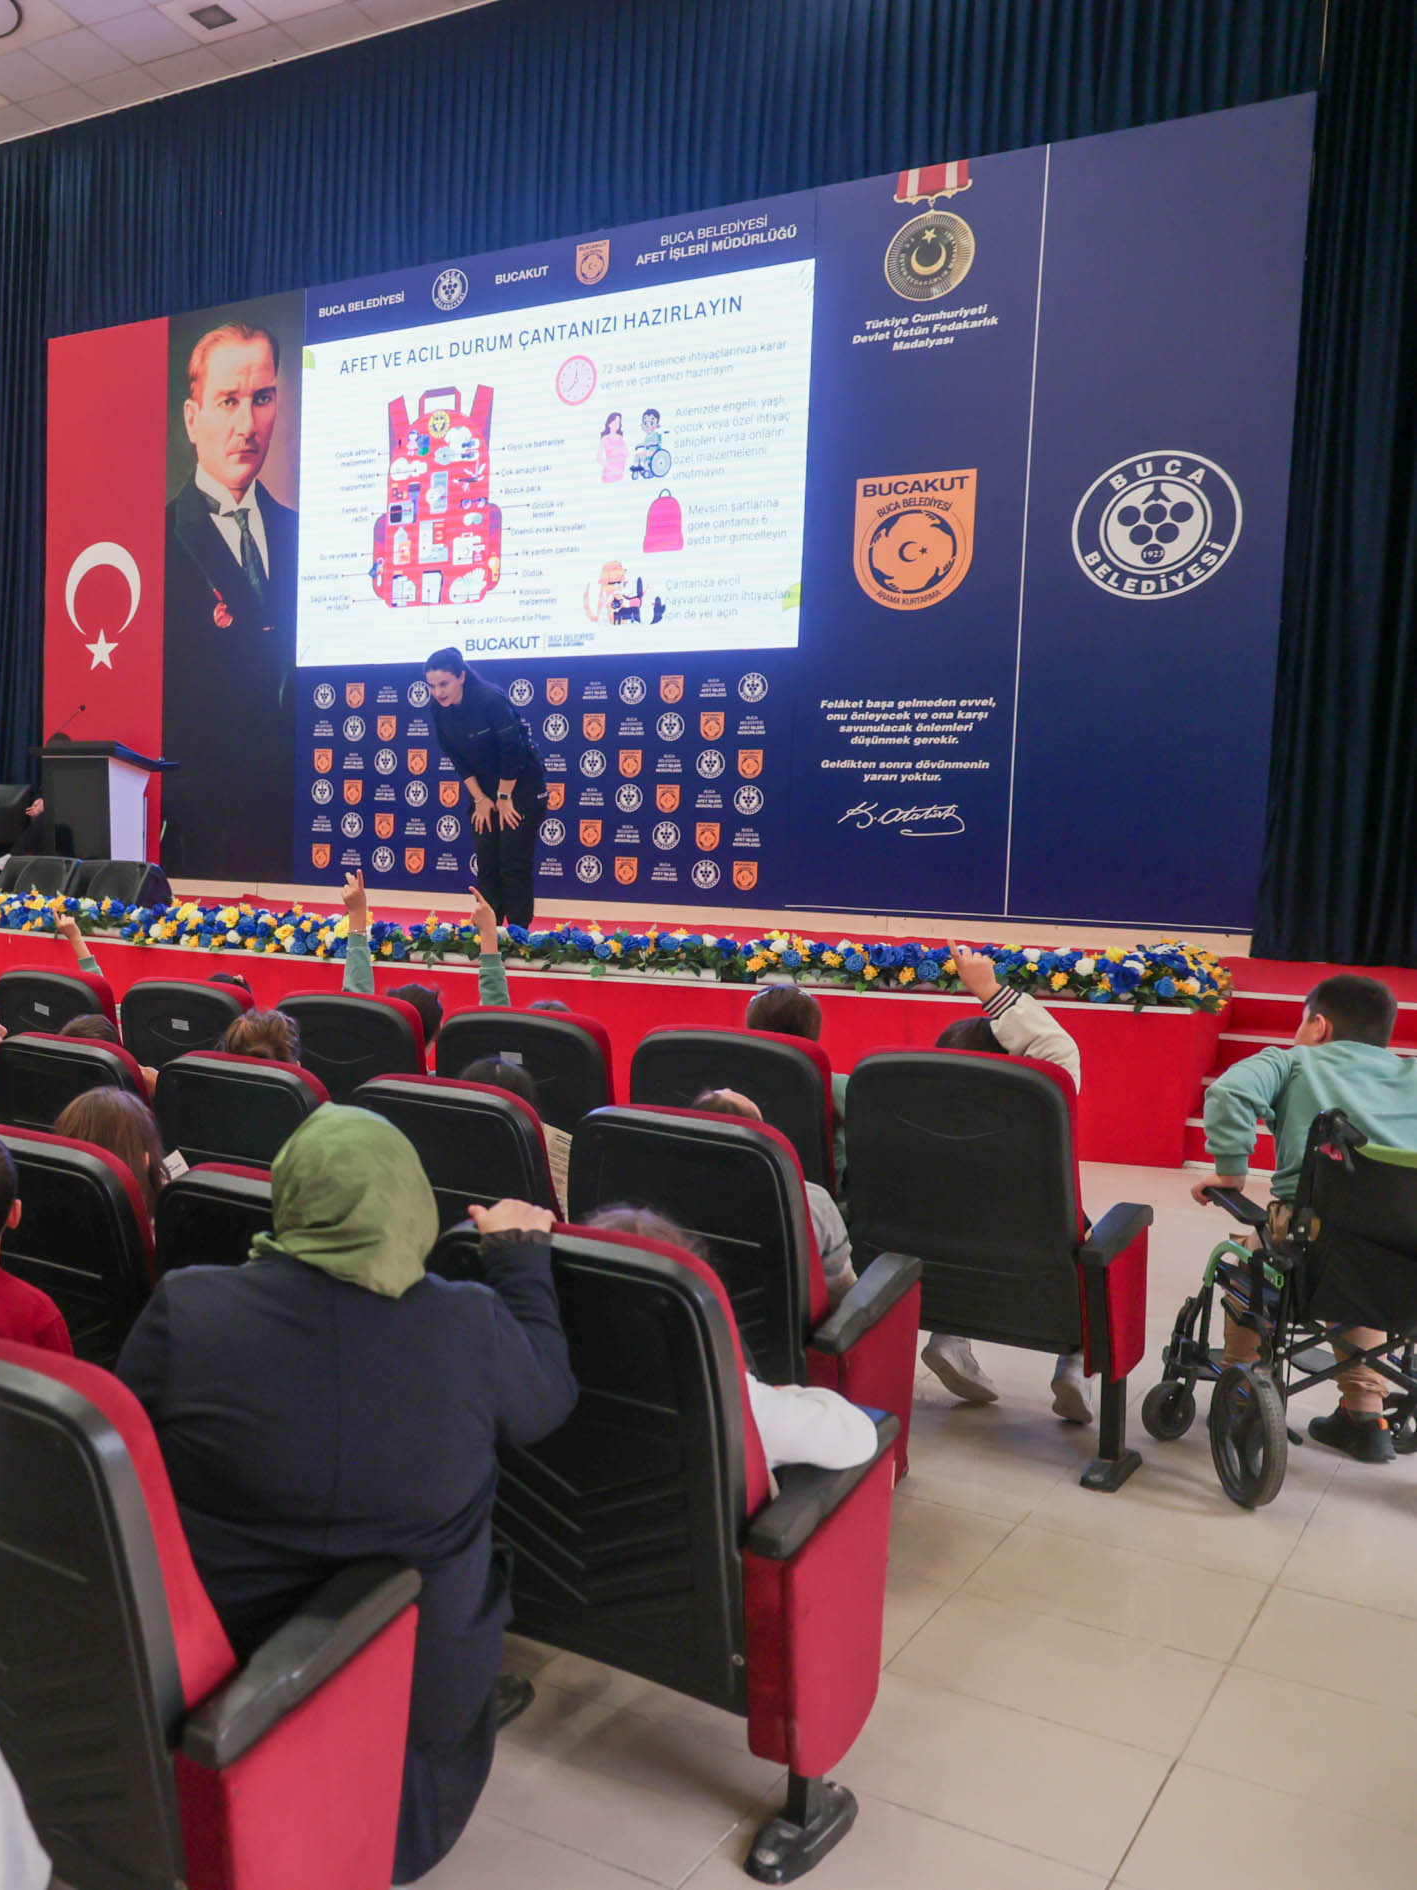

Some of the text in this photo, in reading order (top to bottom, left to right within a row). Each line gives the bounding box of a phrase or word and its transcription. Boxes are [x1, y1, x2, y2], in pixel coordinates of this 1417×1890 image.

[661, 214, 768, 246] BUCA BELEDİYESİ
[635, 223, 797, 266] AFET İŞLERİ MÜDÜRLÜĞÜ
[495, 265, 549, 285] BUCAKUT
[318, 290, 405, 318] BUCA BELEDİYESİ
[865, 304, 988, 330] Türkiye Cumhuriyeti
[339, 354, 377, 375] AFET
[383, 351, 402, 368] VE
[449, 333, 513, 358] DURUM
[518, 315, 618, 350] ÇANTANIZI
[624, 295, 743, 330] HAZIRLAYIN
[852, 315, 999, 344] Devlet Üstün Fedakarlık
[892, 336, 955, 351] Madalyası
[615, 360, 636, 374] saat
[1108, 460, 1206, 491] BUCA
[862, 476, 970, 498] BUCAKUT
[876, 496, 953, 518] BUCA BELEDİYESİ
[1142, 550, 1165, 559] 1923
[1084, 541, 1226, 594] BELEDİYESİ
[465, 635, 540, 651] BUCAKUT
[866, 699, 895, 711] başa
[897, 698, 956, 710] gelmeden
[959, 697, 997, 708] evvel,
[826, 710, 989, 722] onu önleyecek ve ona karşı
[839, 722, 974, 733] savunulacak önlemleri
[850, 735, 959, 746] düşünmek gerekir.
[821, 759, 990, 769] Geldikten sonra dövünmenin
[863, 772, 942, 783] yararı yoktur.
